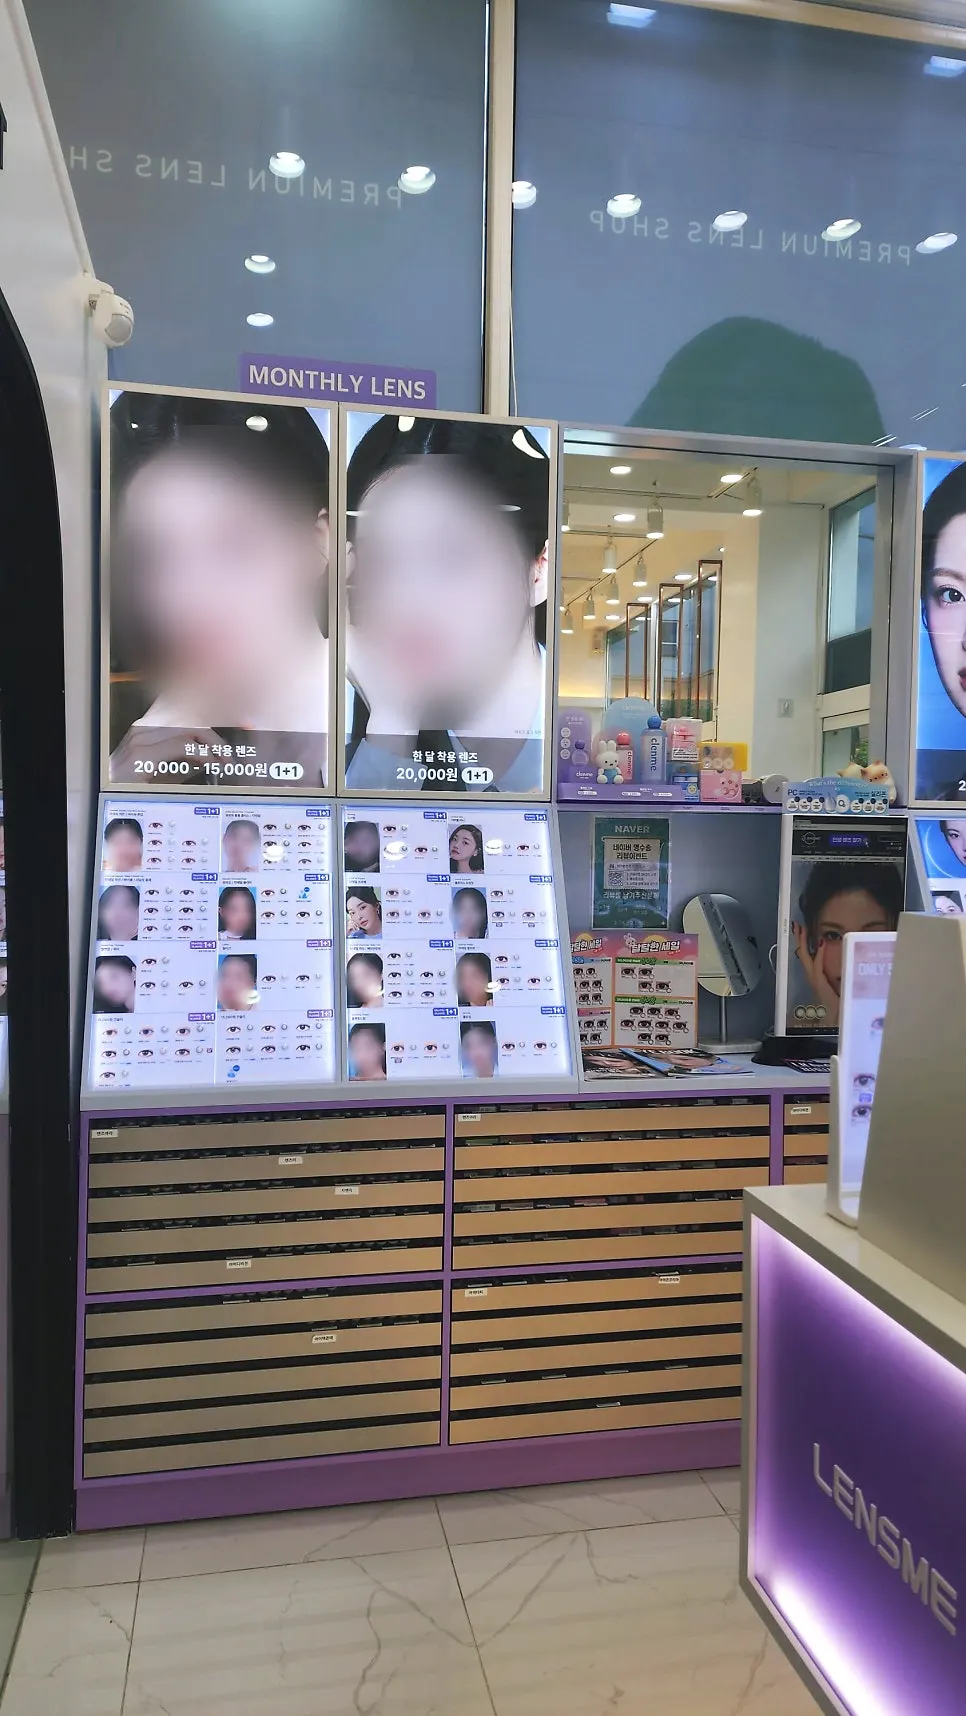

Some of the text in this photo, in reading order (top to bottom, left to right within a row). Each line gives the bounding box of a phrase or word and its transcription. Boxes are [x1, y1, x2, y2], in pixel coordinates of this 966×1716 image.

[248, 364, 426, 400] MONTHLY LENS
[184, 744, 257, 758] 한 달 착용 렌즈
[412, 751, 478, 763] 한 달 착용 렌즈
[134, 760, 190, 777] 20,000
[203, 762, 268, 778] 15,000원
[274, 765, 298, 777] 1+1
[396, 767, 488, 783] 20,000원 1+1
[615, 825, 650, 833] NAVER
[660, 940, 680, 951] 세일
[859, 963, 885, 975] ONLY
[813, 1442, 957, 1636] LENSME
